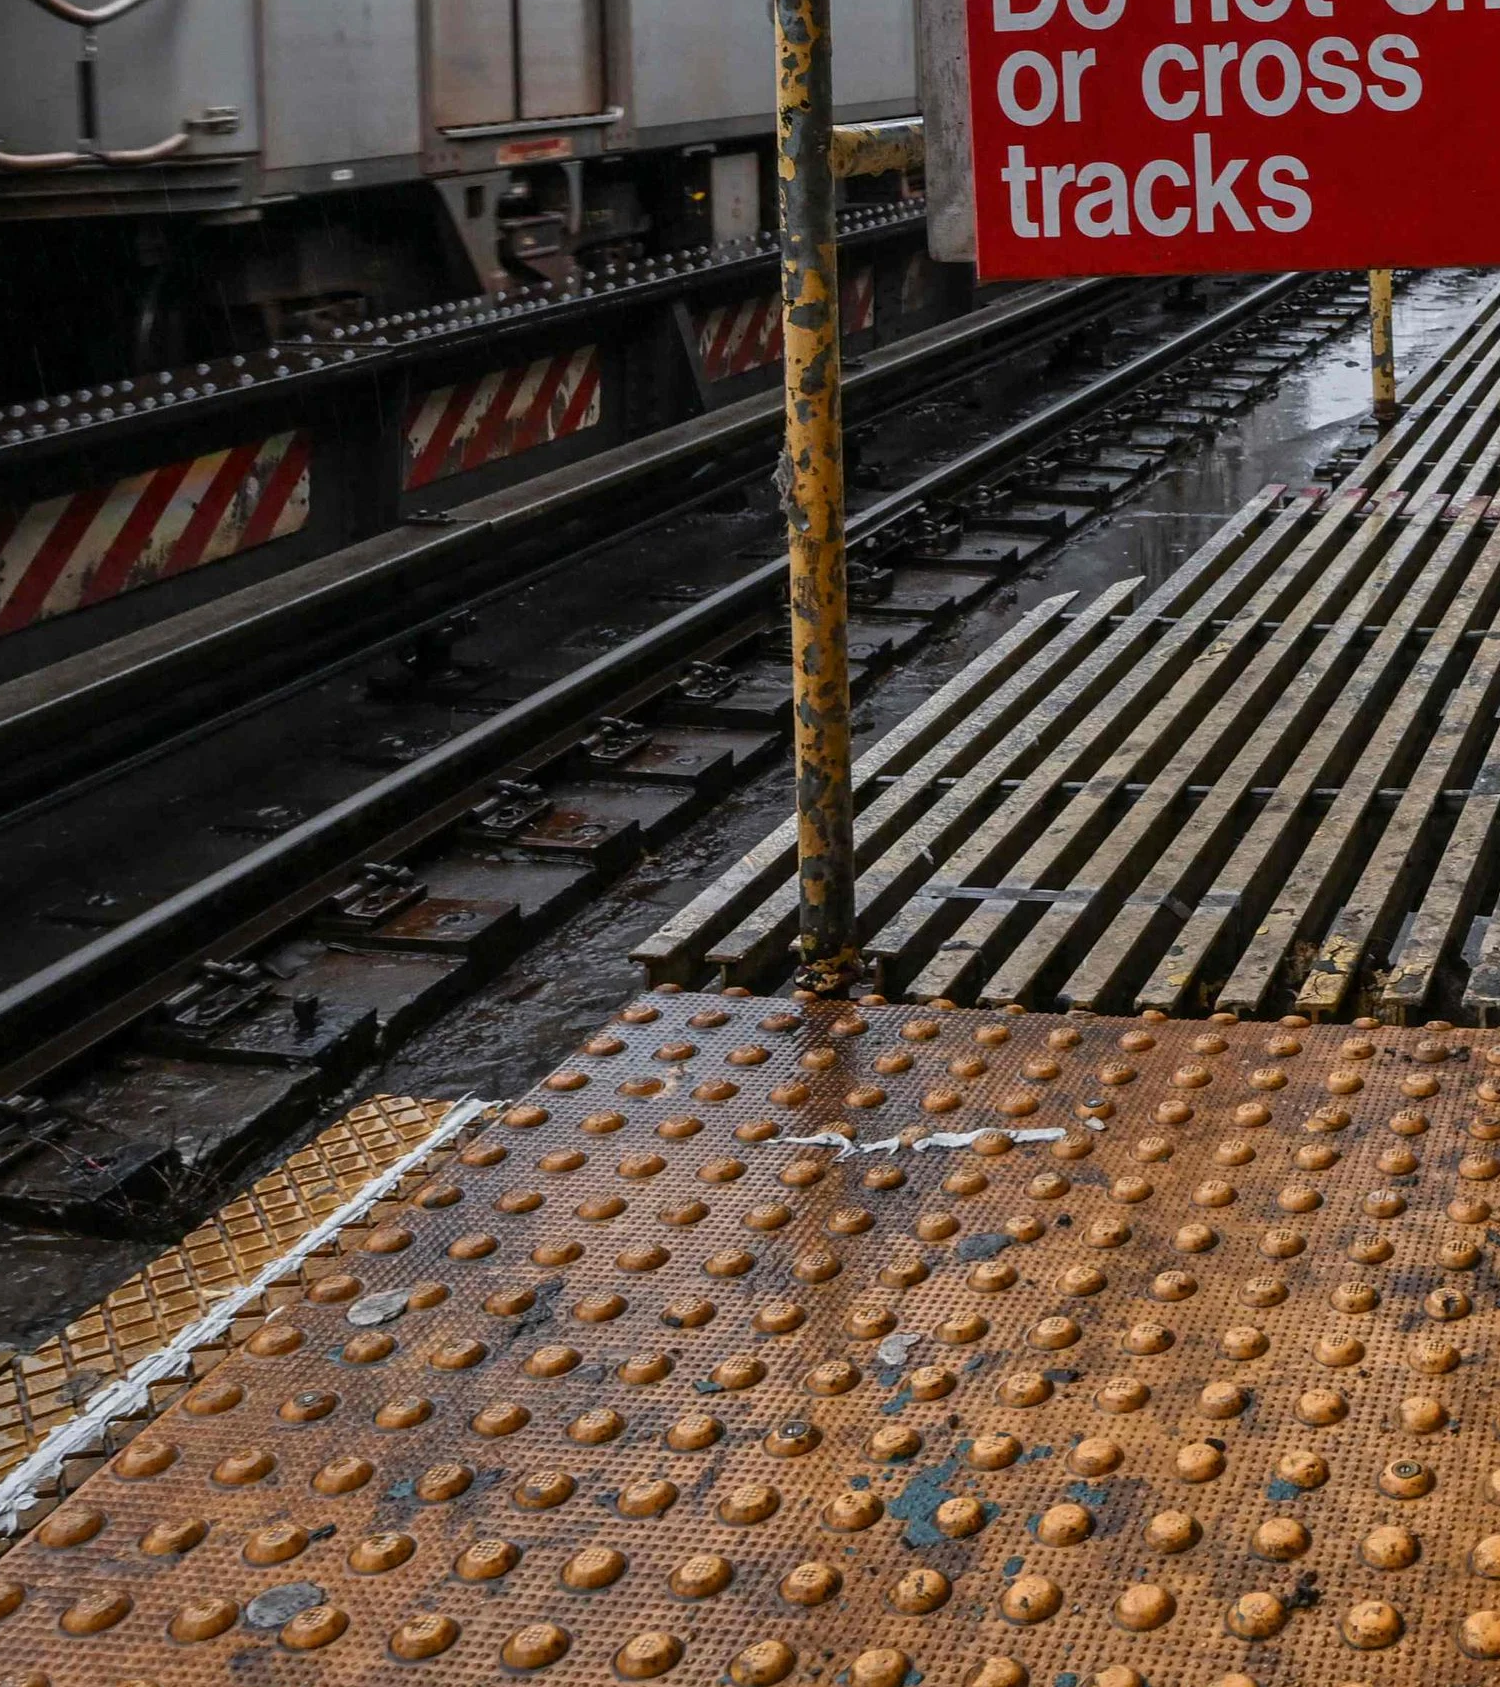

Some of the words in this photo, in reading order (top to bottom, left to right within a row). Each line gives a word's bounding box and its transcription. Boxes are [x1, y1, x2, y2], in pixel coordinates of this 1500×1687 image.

[996, 47, 1097, 127] or
[1141, 33, 1424, 122] cross
[1000, 131, 1313, 240] tracks
